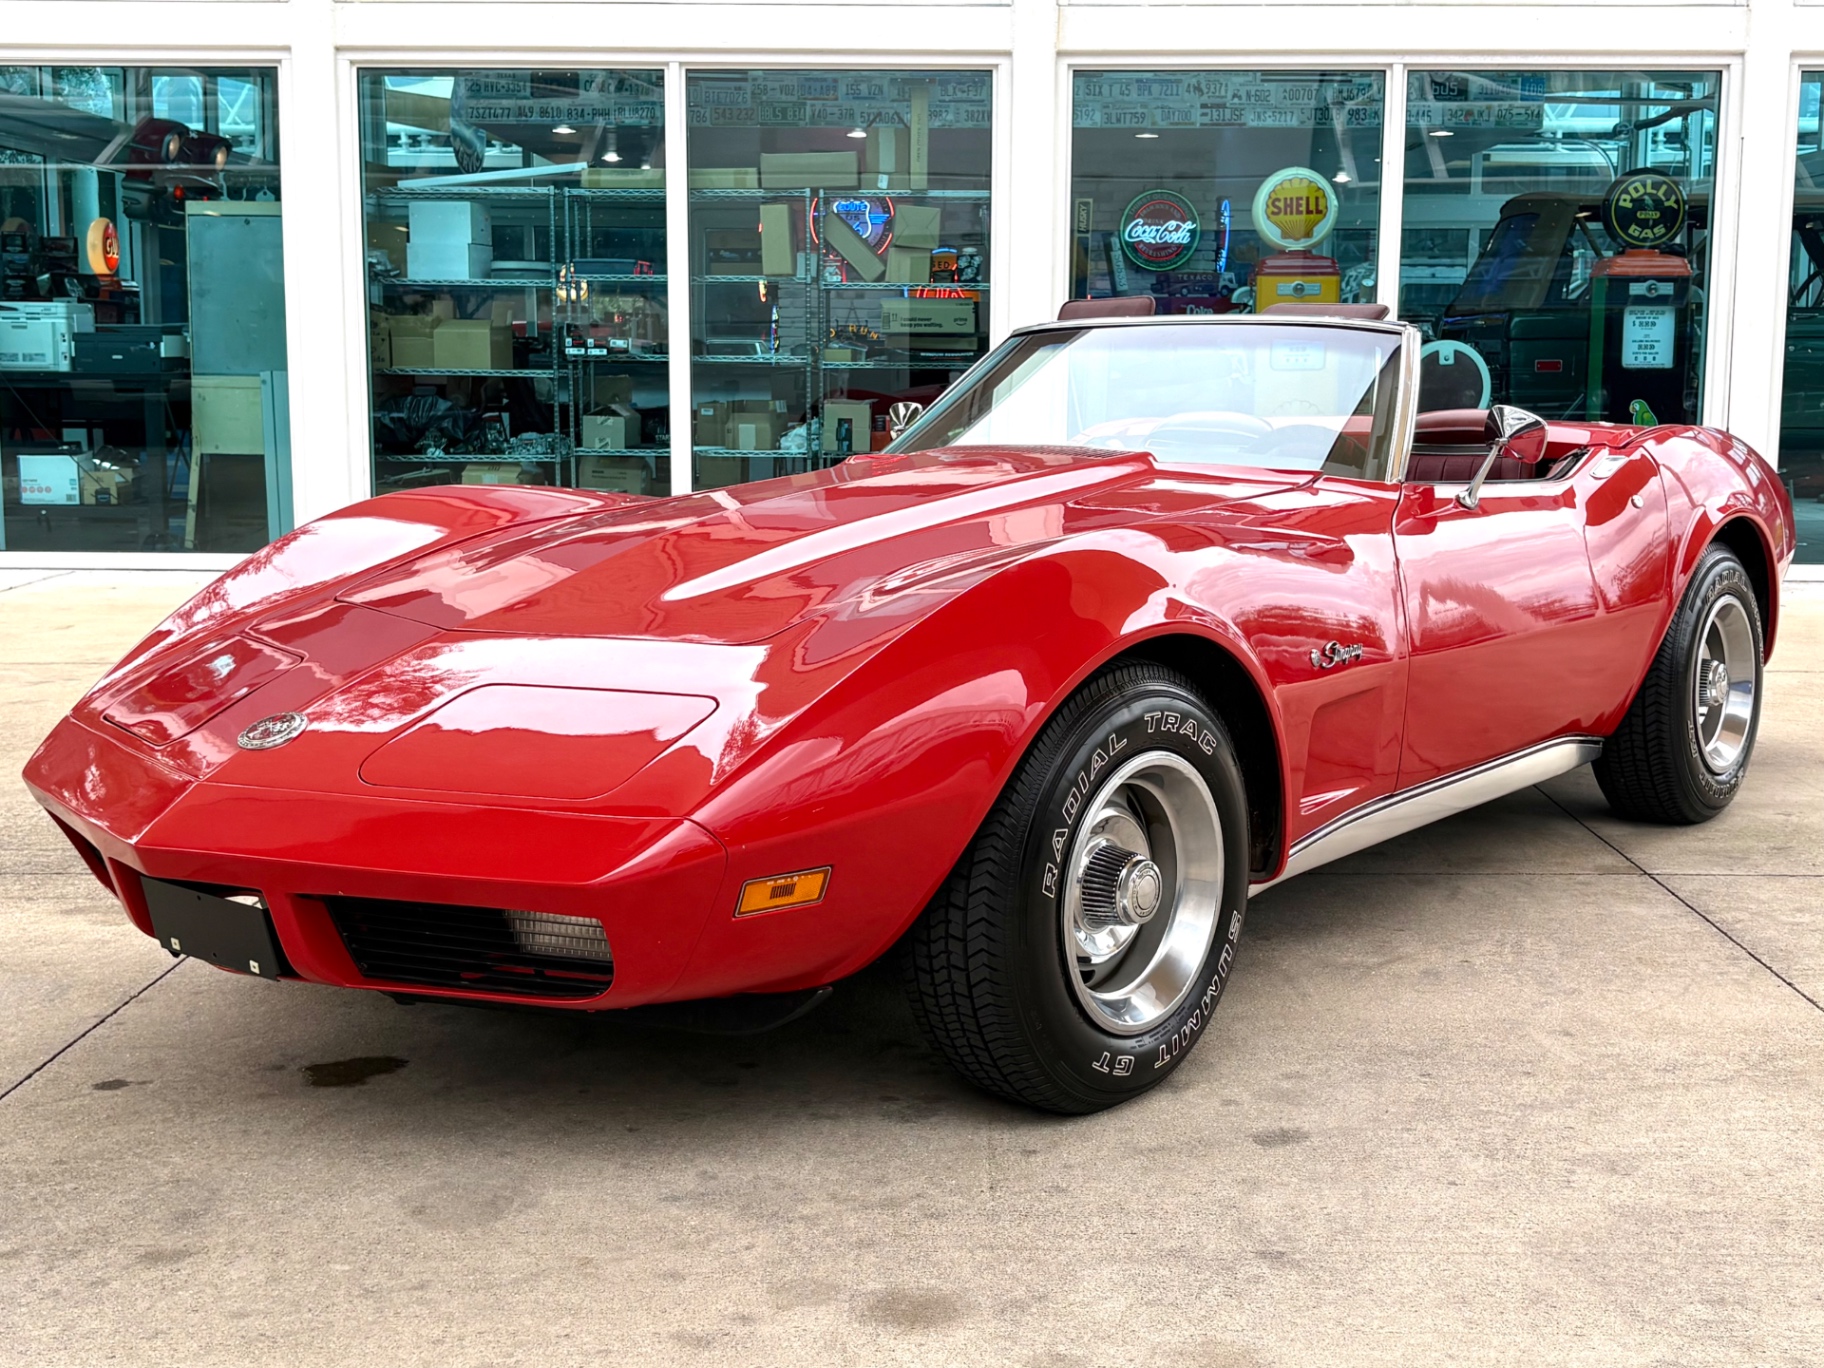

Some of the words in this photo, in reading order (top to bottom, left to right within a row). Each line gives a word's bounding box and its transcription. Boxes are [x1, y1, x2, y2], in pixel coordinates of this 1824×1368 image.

[1271, 196, 1324, 216] SHELL
[1618, 179, 1679, 209] POLLY
[1078, 204, 1088, 232] HUSKY
[1628, 223, 1666, 239] GAS
[1041, 733, 1127, 899] RADIAL
[1144, 711, 1217, 756] TRAC
[1154, 909, 1242, 1070] SUMMIT
[1092, 1051, 1135, 1076] GT
